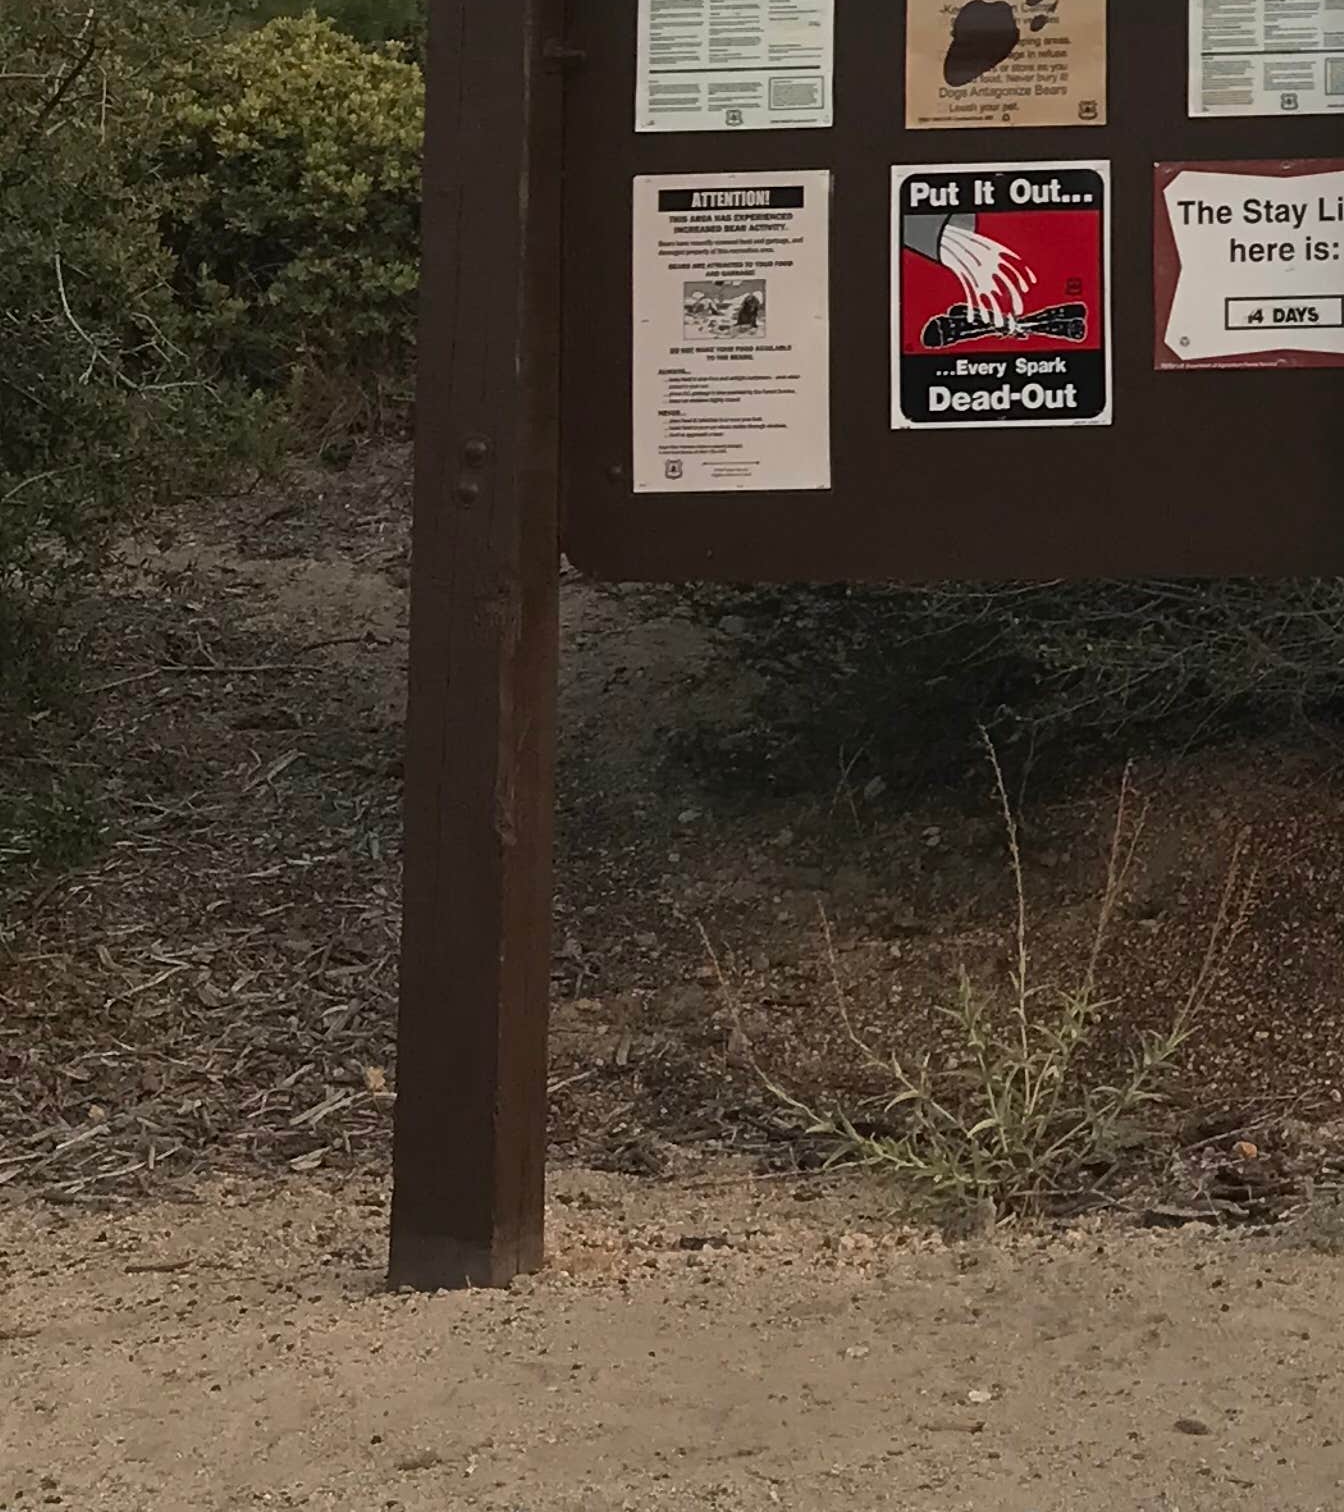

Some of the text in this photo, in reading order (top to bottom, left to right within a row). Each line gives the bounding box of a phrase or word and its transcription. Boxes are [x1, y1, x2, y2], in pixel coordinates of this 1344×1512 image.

[939, 83, 1068, 100] Dogs Antagonize Bears
[690, 190, 771, 208] ATTENTION!
[909, 177, 1094, 208] Put It Out...
[1176, 199, 1233, 226] The
[1242, 198, 1308, 230] Stay
[1229, 235, 1341, 263] here is:
[1272, 306, 1320, 324] DAYS
[1014, 356, 1067, 377] Spark
[928, 382, 1078, 412] Dead-Out
